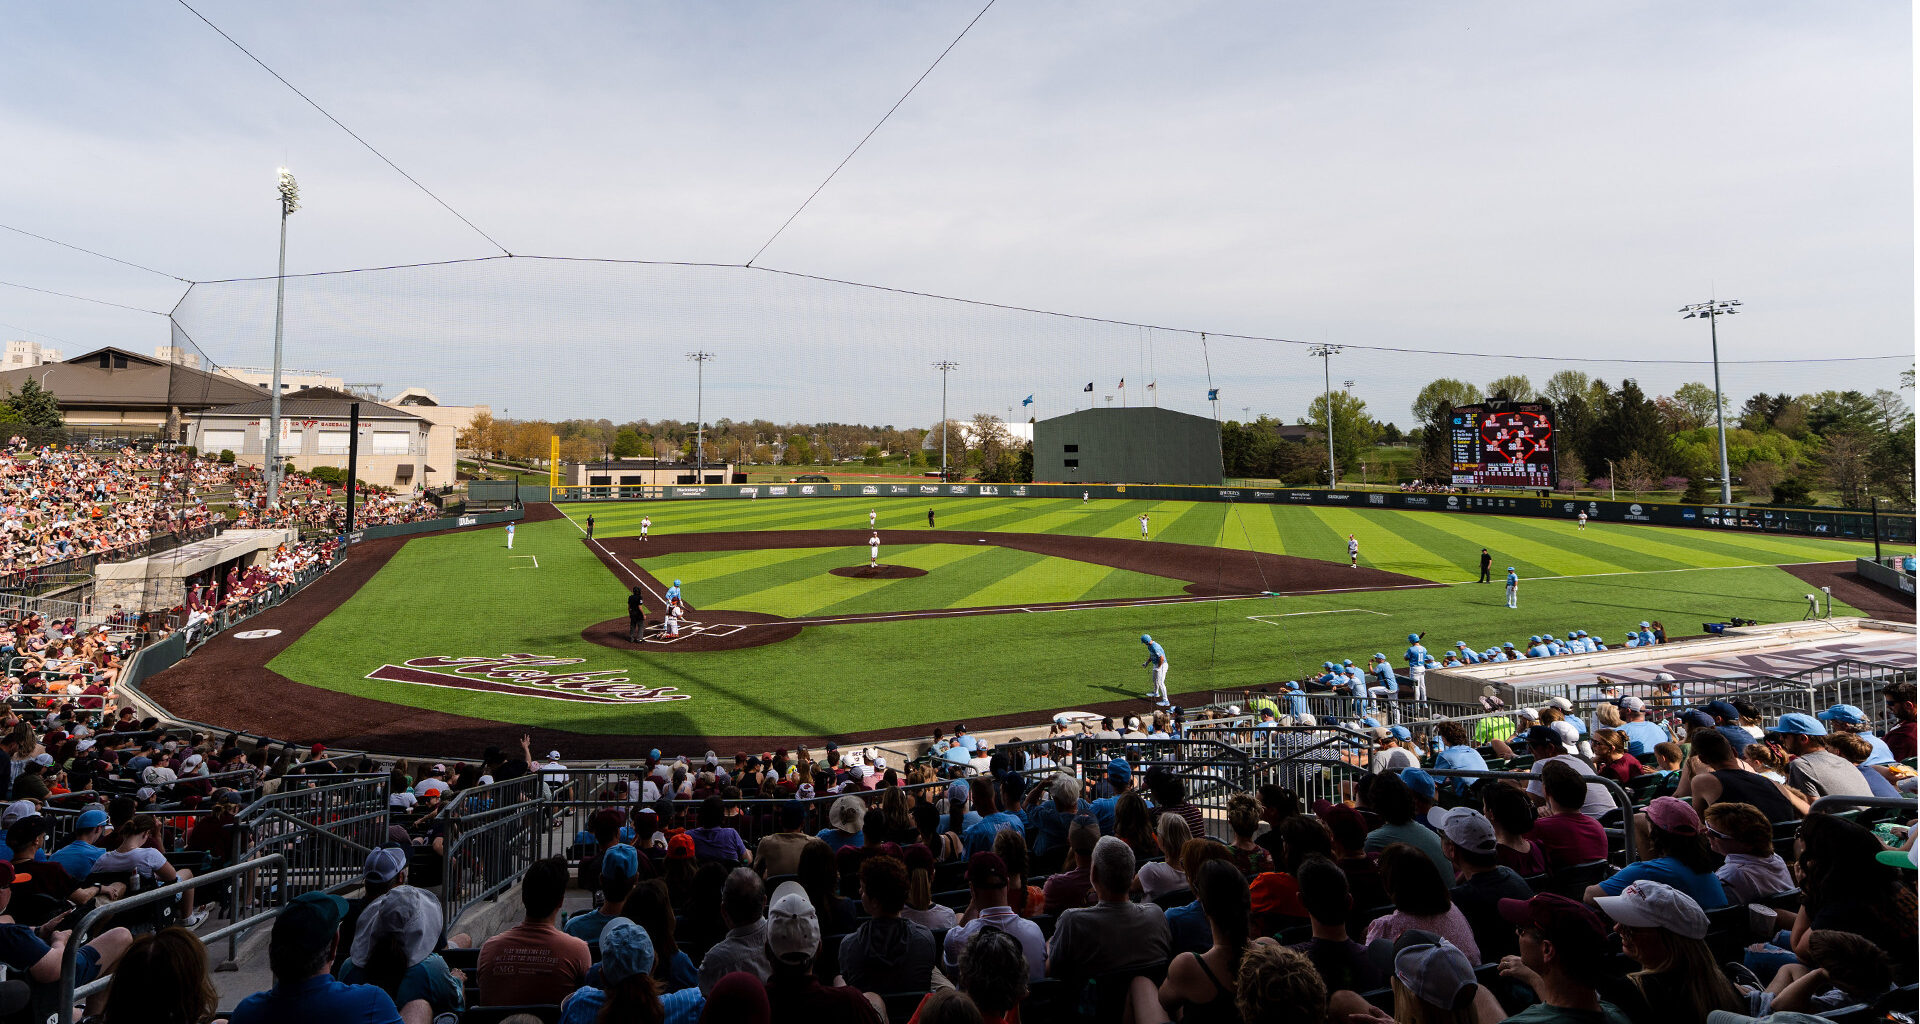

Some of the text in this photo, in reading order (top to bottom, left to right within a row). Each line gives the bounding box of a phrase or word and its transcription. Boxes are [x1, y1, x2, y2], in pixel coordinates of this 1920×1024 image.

[1487, 401, 1506, 409] VT
[303, 420, 319, 428] VT
[1540, 500, 1552, 508] 375
